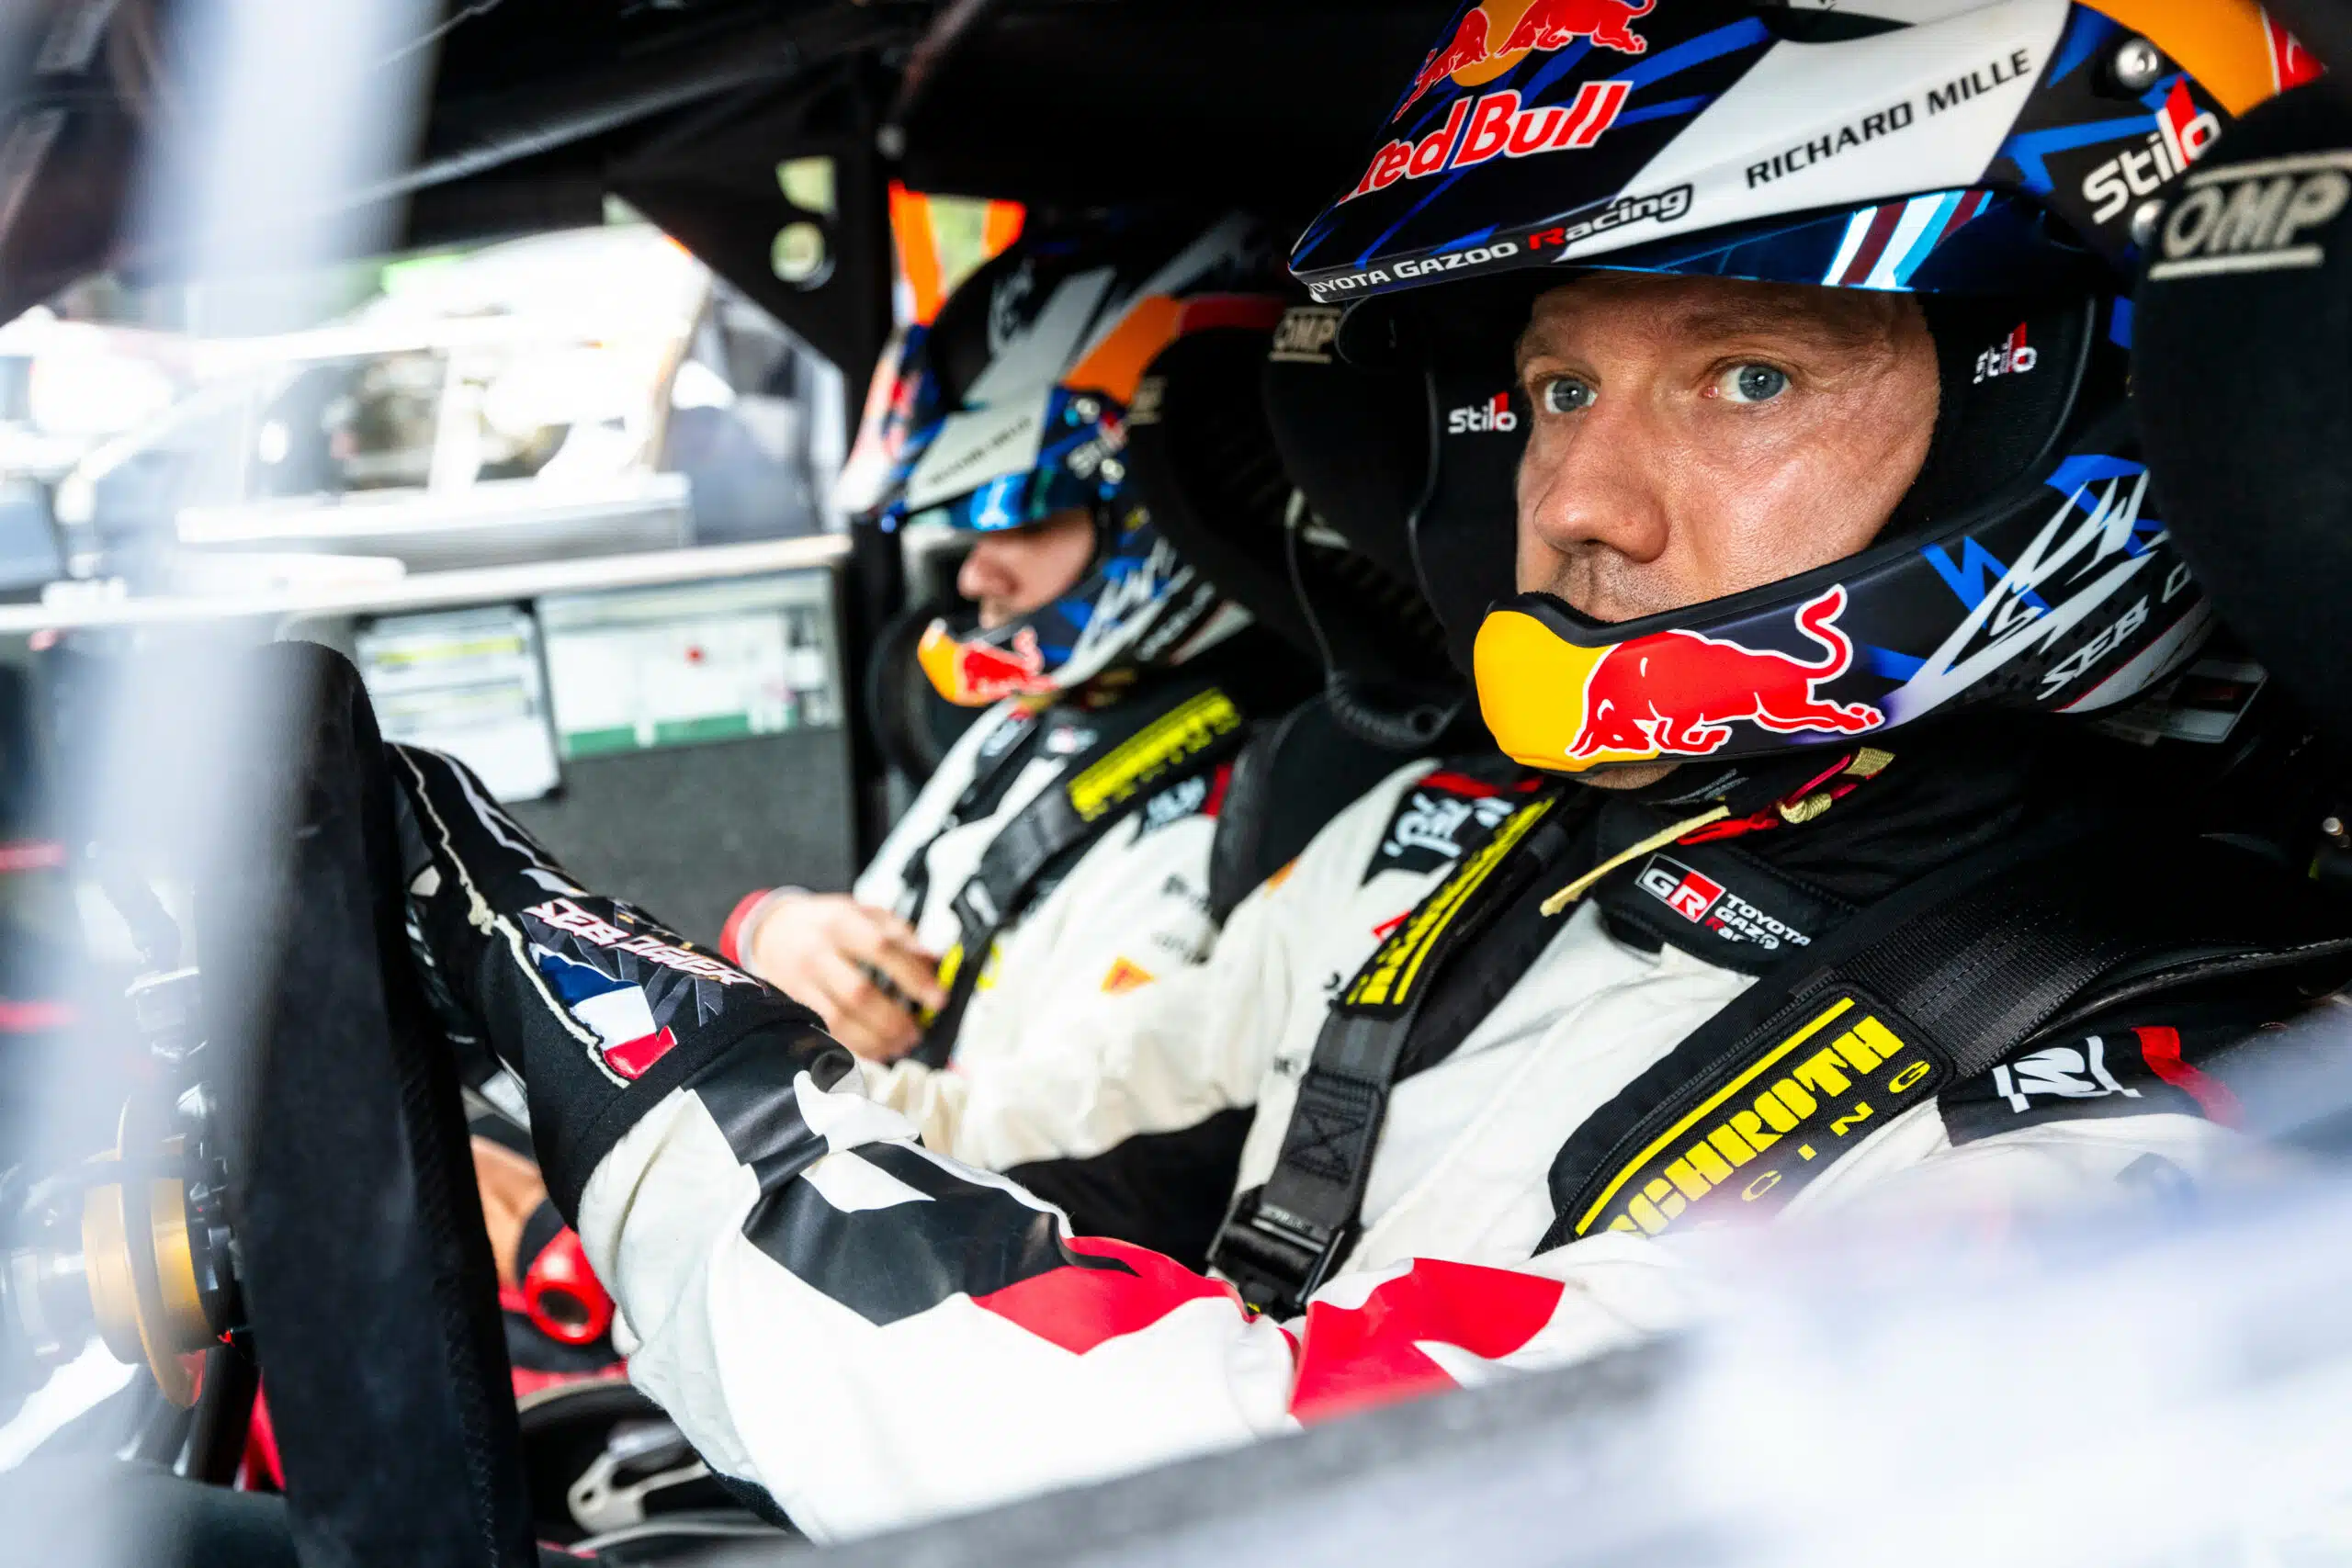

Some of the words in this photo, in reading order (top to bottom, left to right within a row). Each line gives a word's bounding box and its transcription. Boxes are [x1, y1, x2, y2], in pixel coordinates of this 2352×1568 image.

[1448, 79, 1635, 171] Bull
[1746, 100, 1915, 190] RICHARD
[1928, 48, 2032, 116] MILLE
[1307, 270, 1391, 295] OYOTA
[1392, 241, 1519, 279] GAZOO
[1527, 182, 1694, 251] Racing
[2163, 171, 2350, 258] OMP
[1642, 867, 1709, 919] GR
[1724, 892, 1812, 947] TOYOTA
[1741, 1060, 1931, 1202] CING
